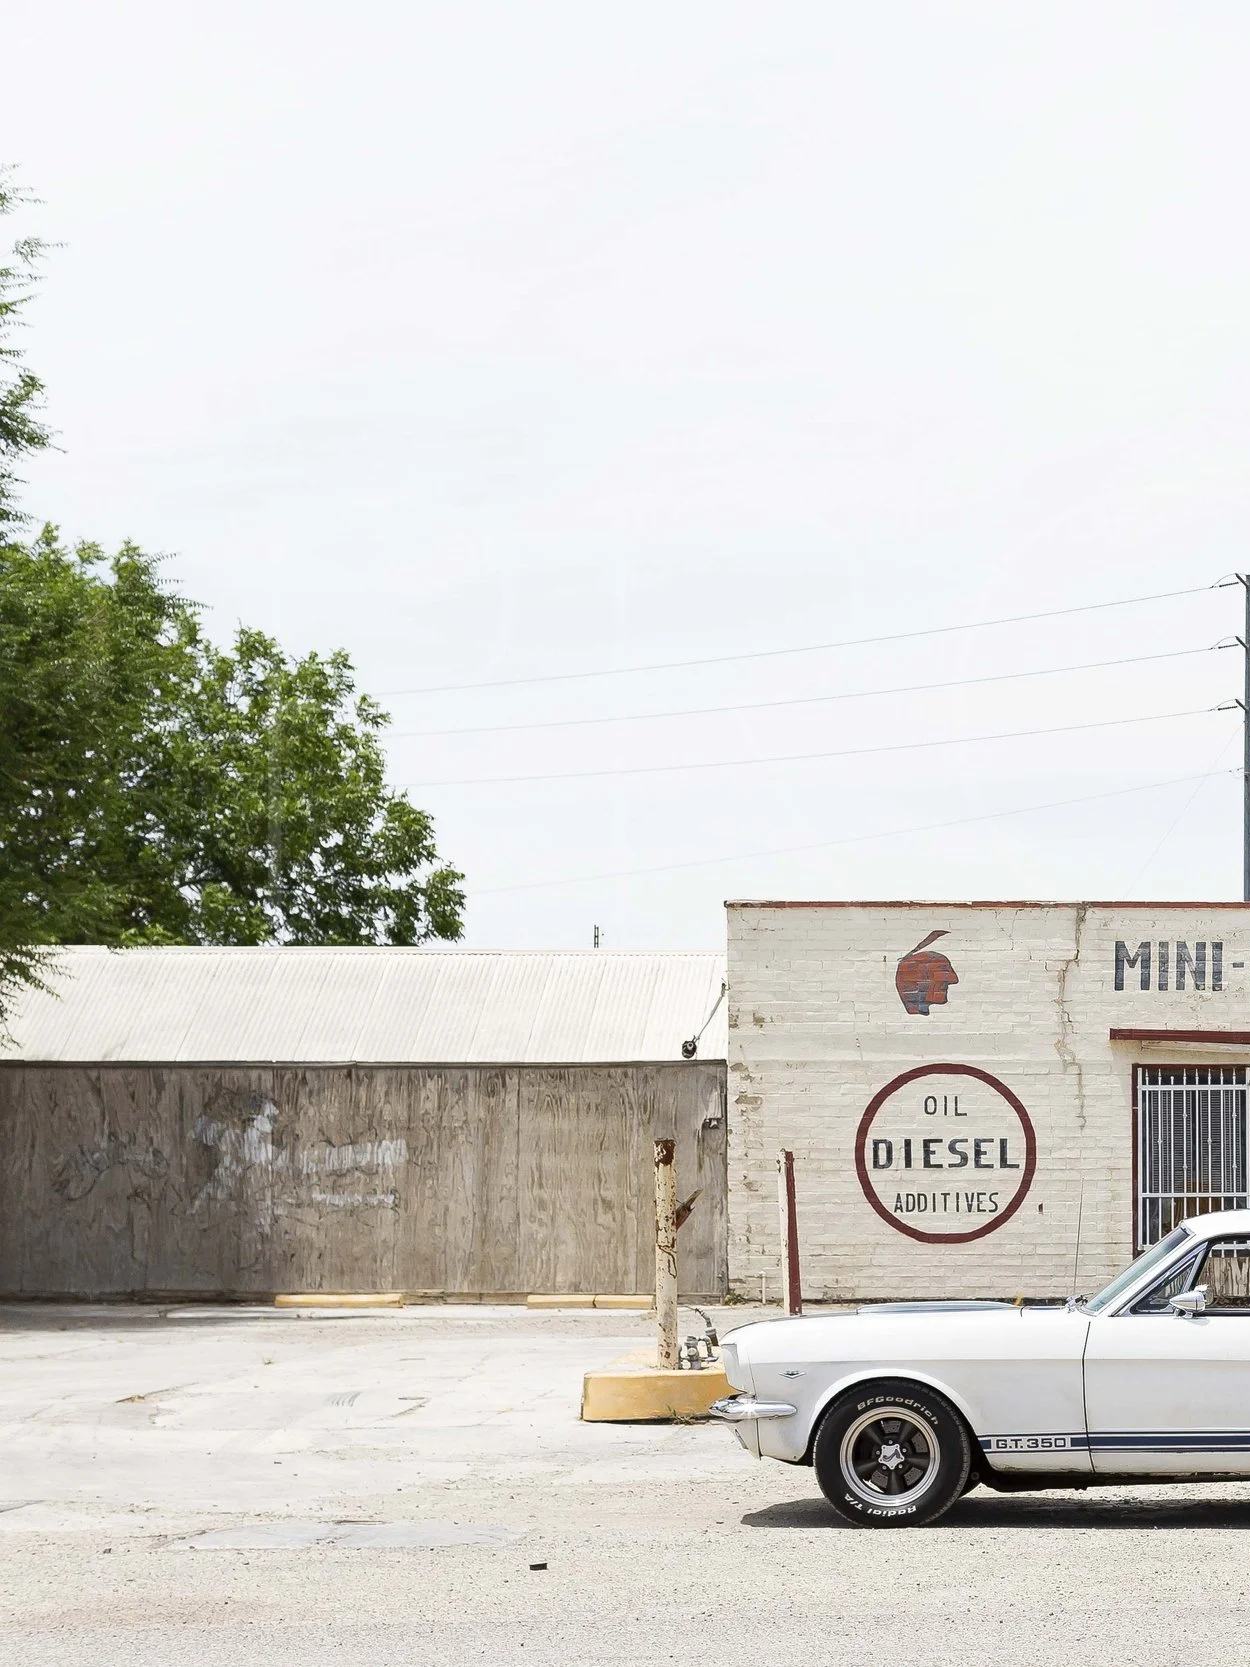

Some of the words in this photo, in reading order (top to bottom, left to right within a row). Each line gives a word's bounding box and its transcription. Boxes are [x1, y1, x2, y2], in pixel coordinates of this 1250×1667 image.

[924, 1095, 968, 1117] OIL
[872, 1138, 1020, 1170] DIESEL
[893, 1191, 999, 1214] ADDITIVES
[857, 1396, 939, 1425] BFGoodrich
[866, 1505, 917, 1517] Radial
